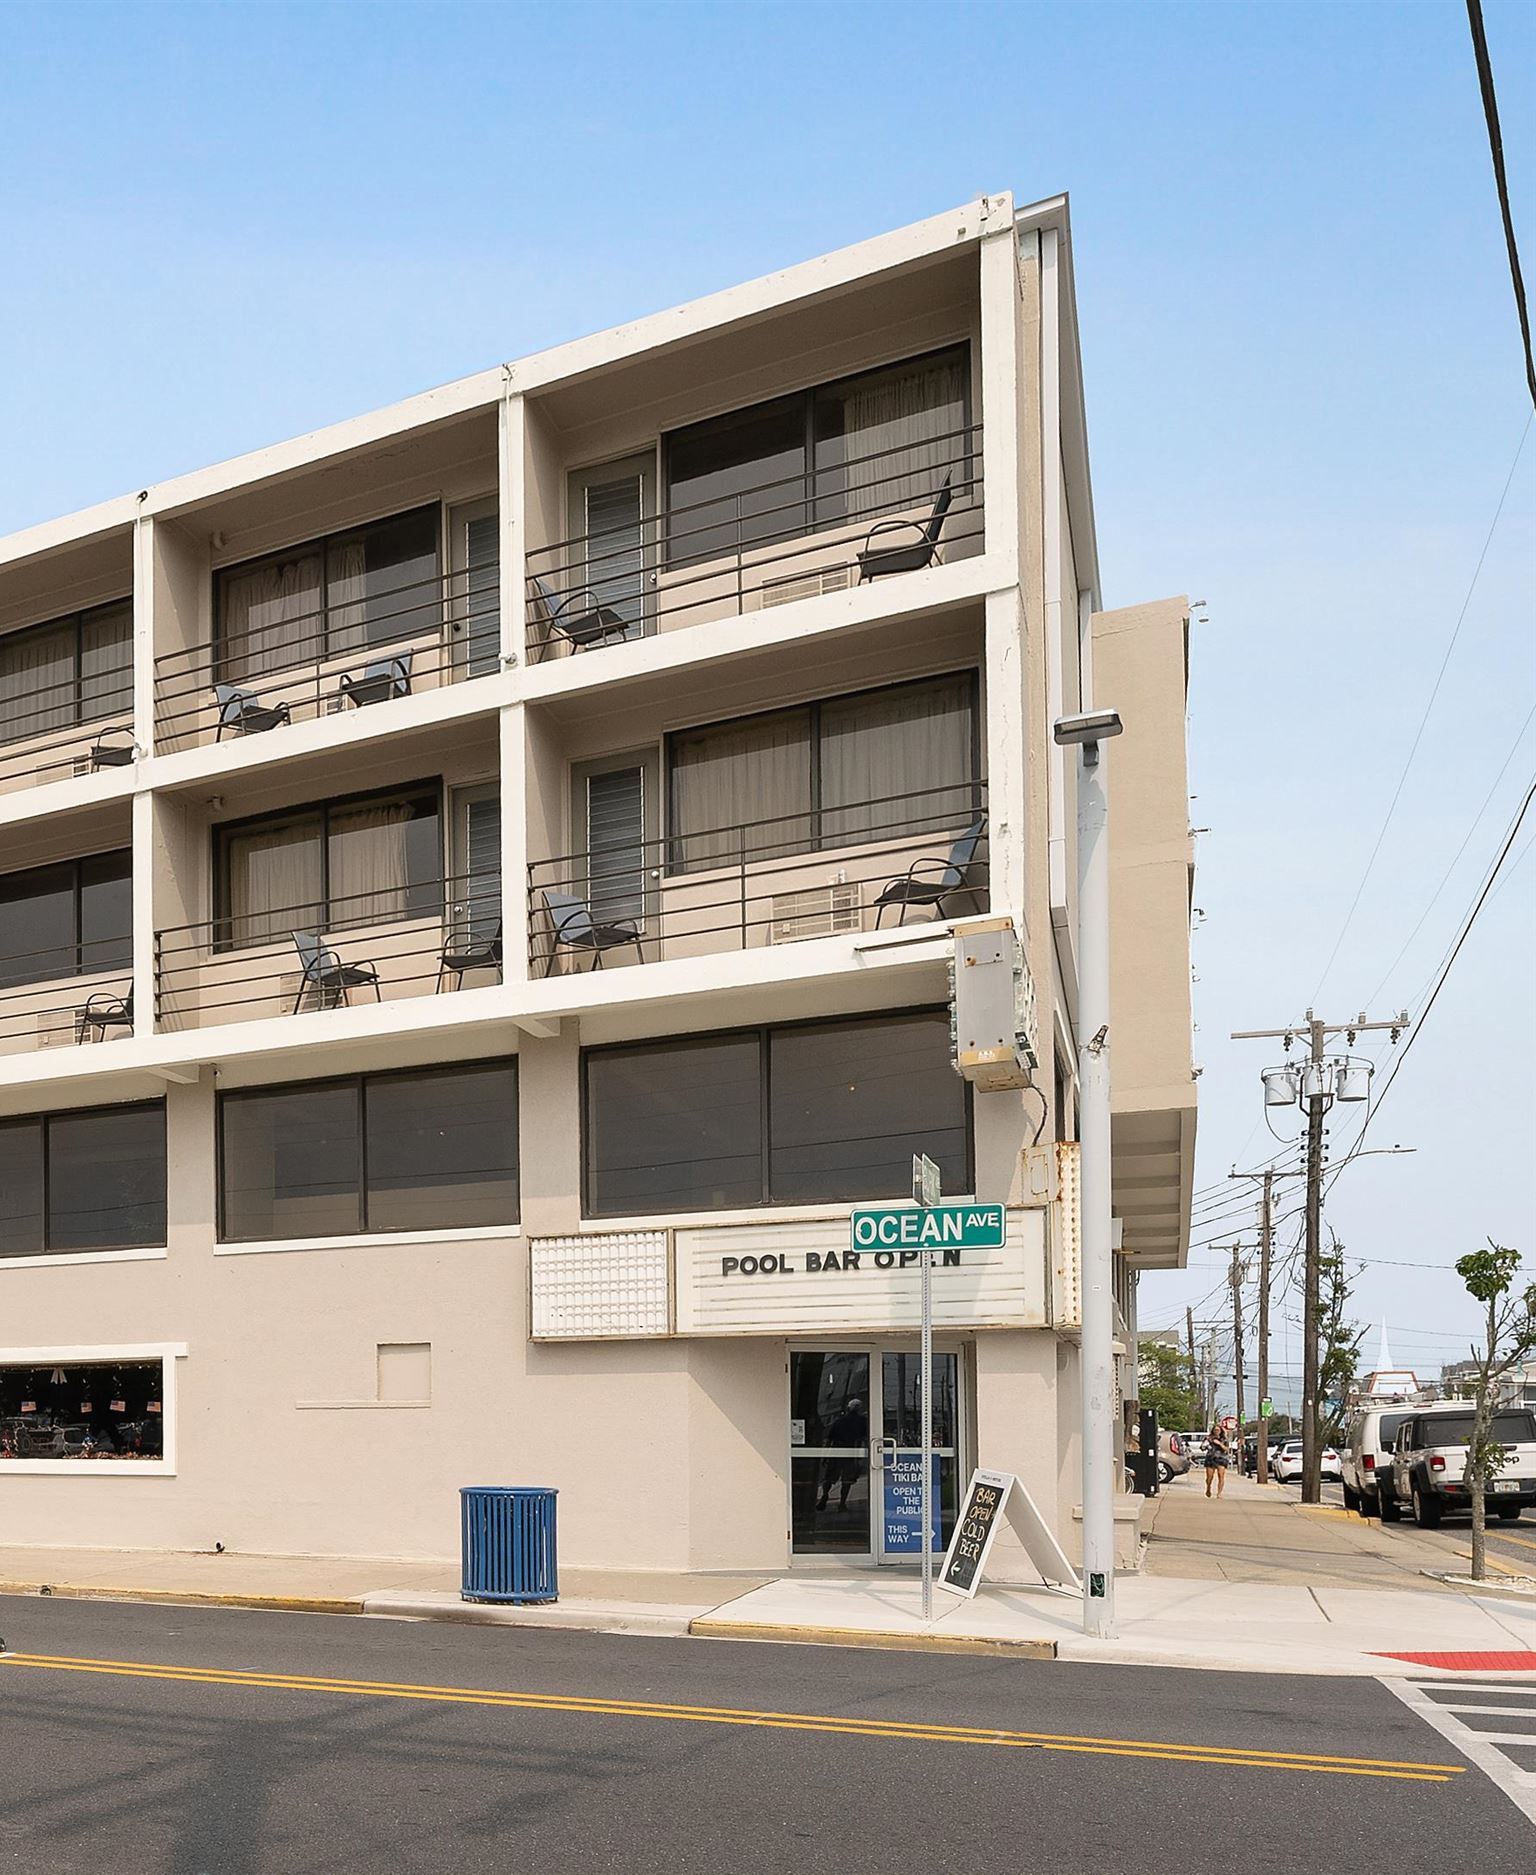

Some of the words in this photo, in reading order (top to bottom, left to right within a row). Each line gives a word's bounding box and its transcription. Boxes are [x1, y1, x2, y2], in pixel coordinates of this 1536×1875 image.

[855, 1212, 963, 1246] OCEAN
[965, 1212, 999, 1228] AVE
[722, 1253, 795, 1276] POOL
[805, 1250, 862, 1272] BAR
[892, 1473, 910, 1482] TIKI
[911, 1473, 923, 1482] BA
[892, 1487, 916, 1496] OPEN
[975, 1487, 996, 1506] BAR
[903, 1496, 920, 1505] THE
[896, 1506, 923, 1515] PUBLI
[969, 1505, 993, 1522] OPEN
[887, 1525, 908, 1534] THIS
[961, 1518, 985, 1542] COLD
[887, 1534, 909, 1544] WAY
[959, 1539, 980, 1562] BEER
